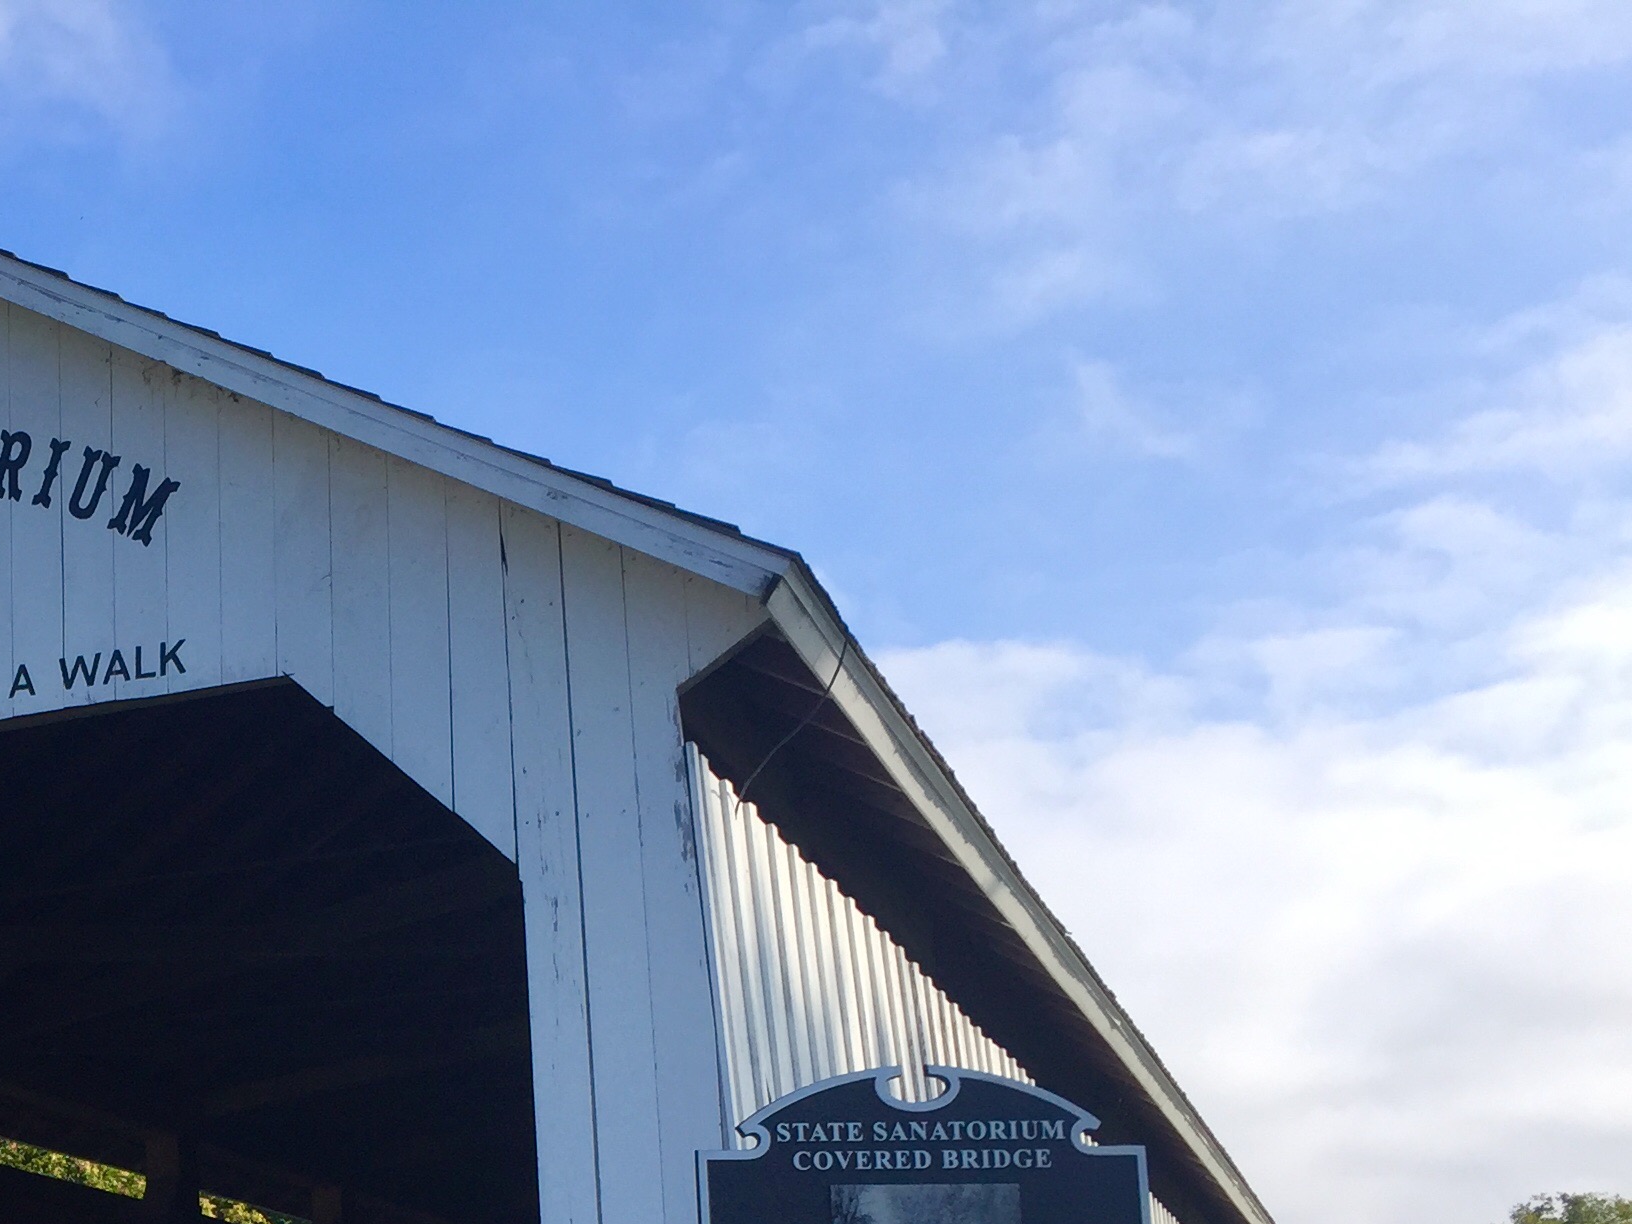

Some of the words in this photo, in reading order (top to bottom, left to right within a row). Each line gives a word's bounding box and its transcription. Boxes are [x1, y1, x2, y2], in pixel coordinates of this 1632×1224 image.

[9, 663, 36, 698] A
[59, 639, 188, 690] WALK
[776, 1122, 864, 1142] STATE
[873, 1120, 1066, 1141] SANATORIUM
[792, 1150, 932, 1171] COVERED
[941, 1149, 1052, 1169] BRIDGE
